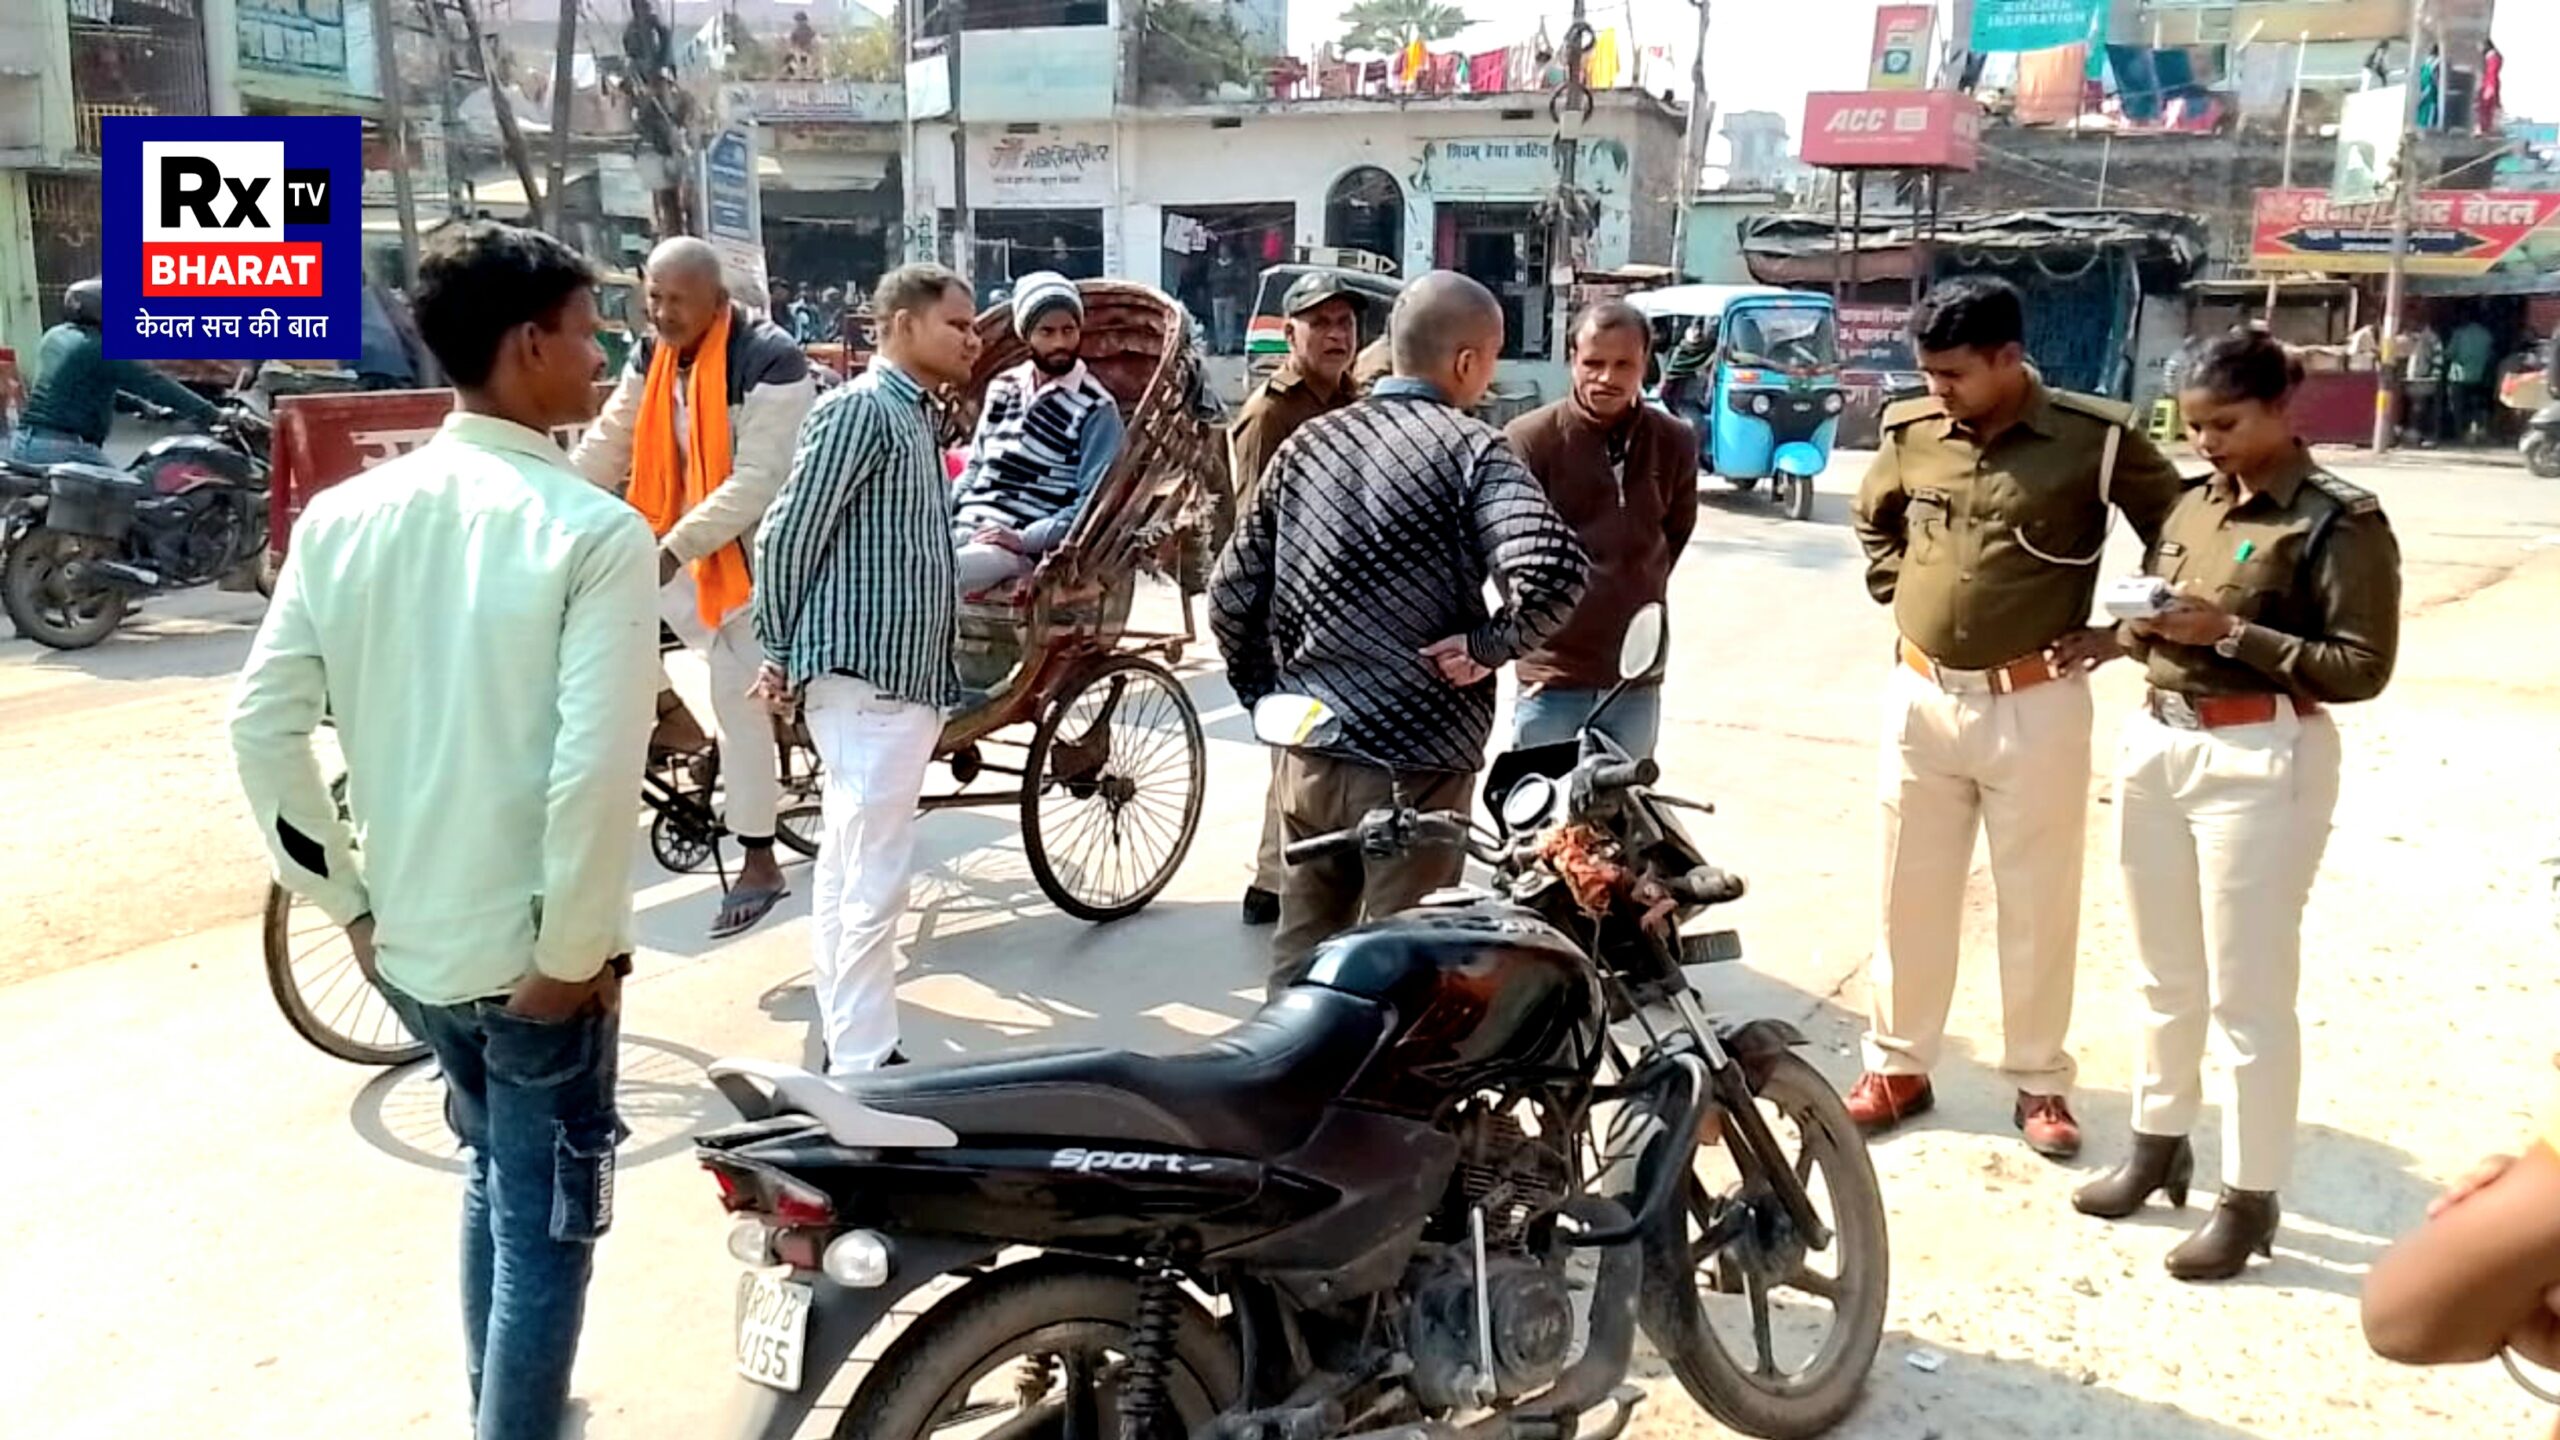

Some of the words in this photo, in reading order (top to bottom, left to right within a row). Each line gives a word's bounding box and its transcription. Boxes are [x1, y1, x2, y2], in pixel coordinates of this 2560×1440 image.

[1987, 12, 2087, 28] INSPIRATION
[1824, 107, 1887, 132] ACC
[2459, 193, 2541, 225] होटल
[1050, 1148, 1185, 1172] Sport
